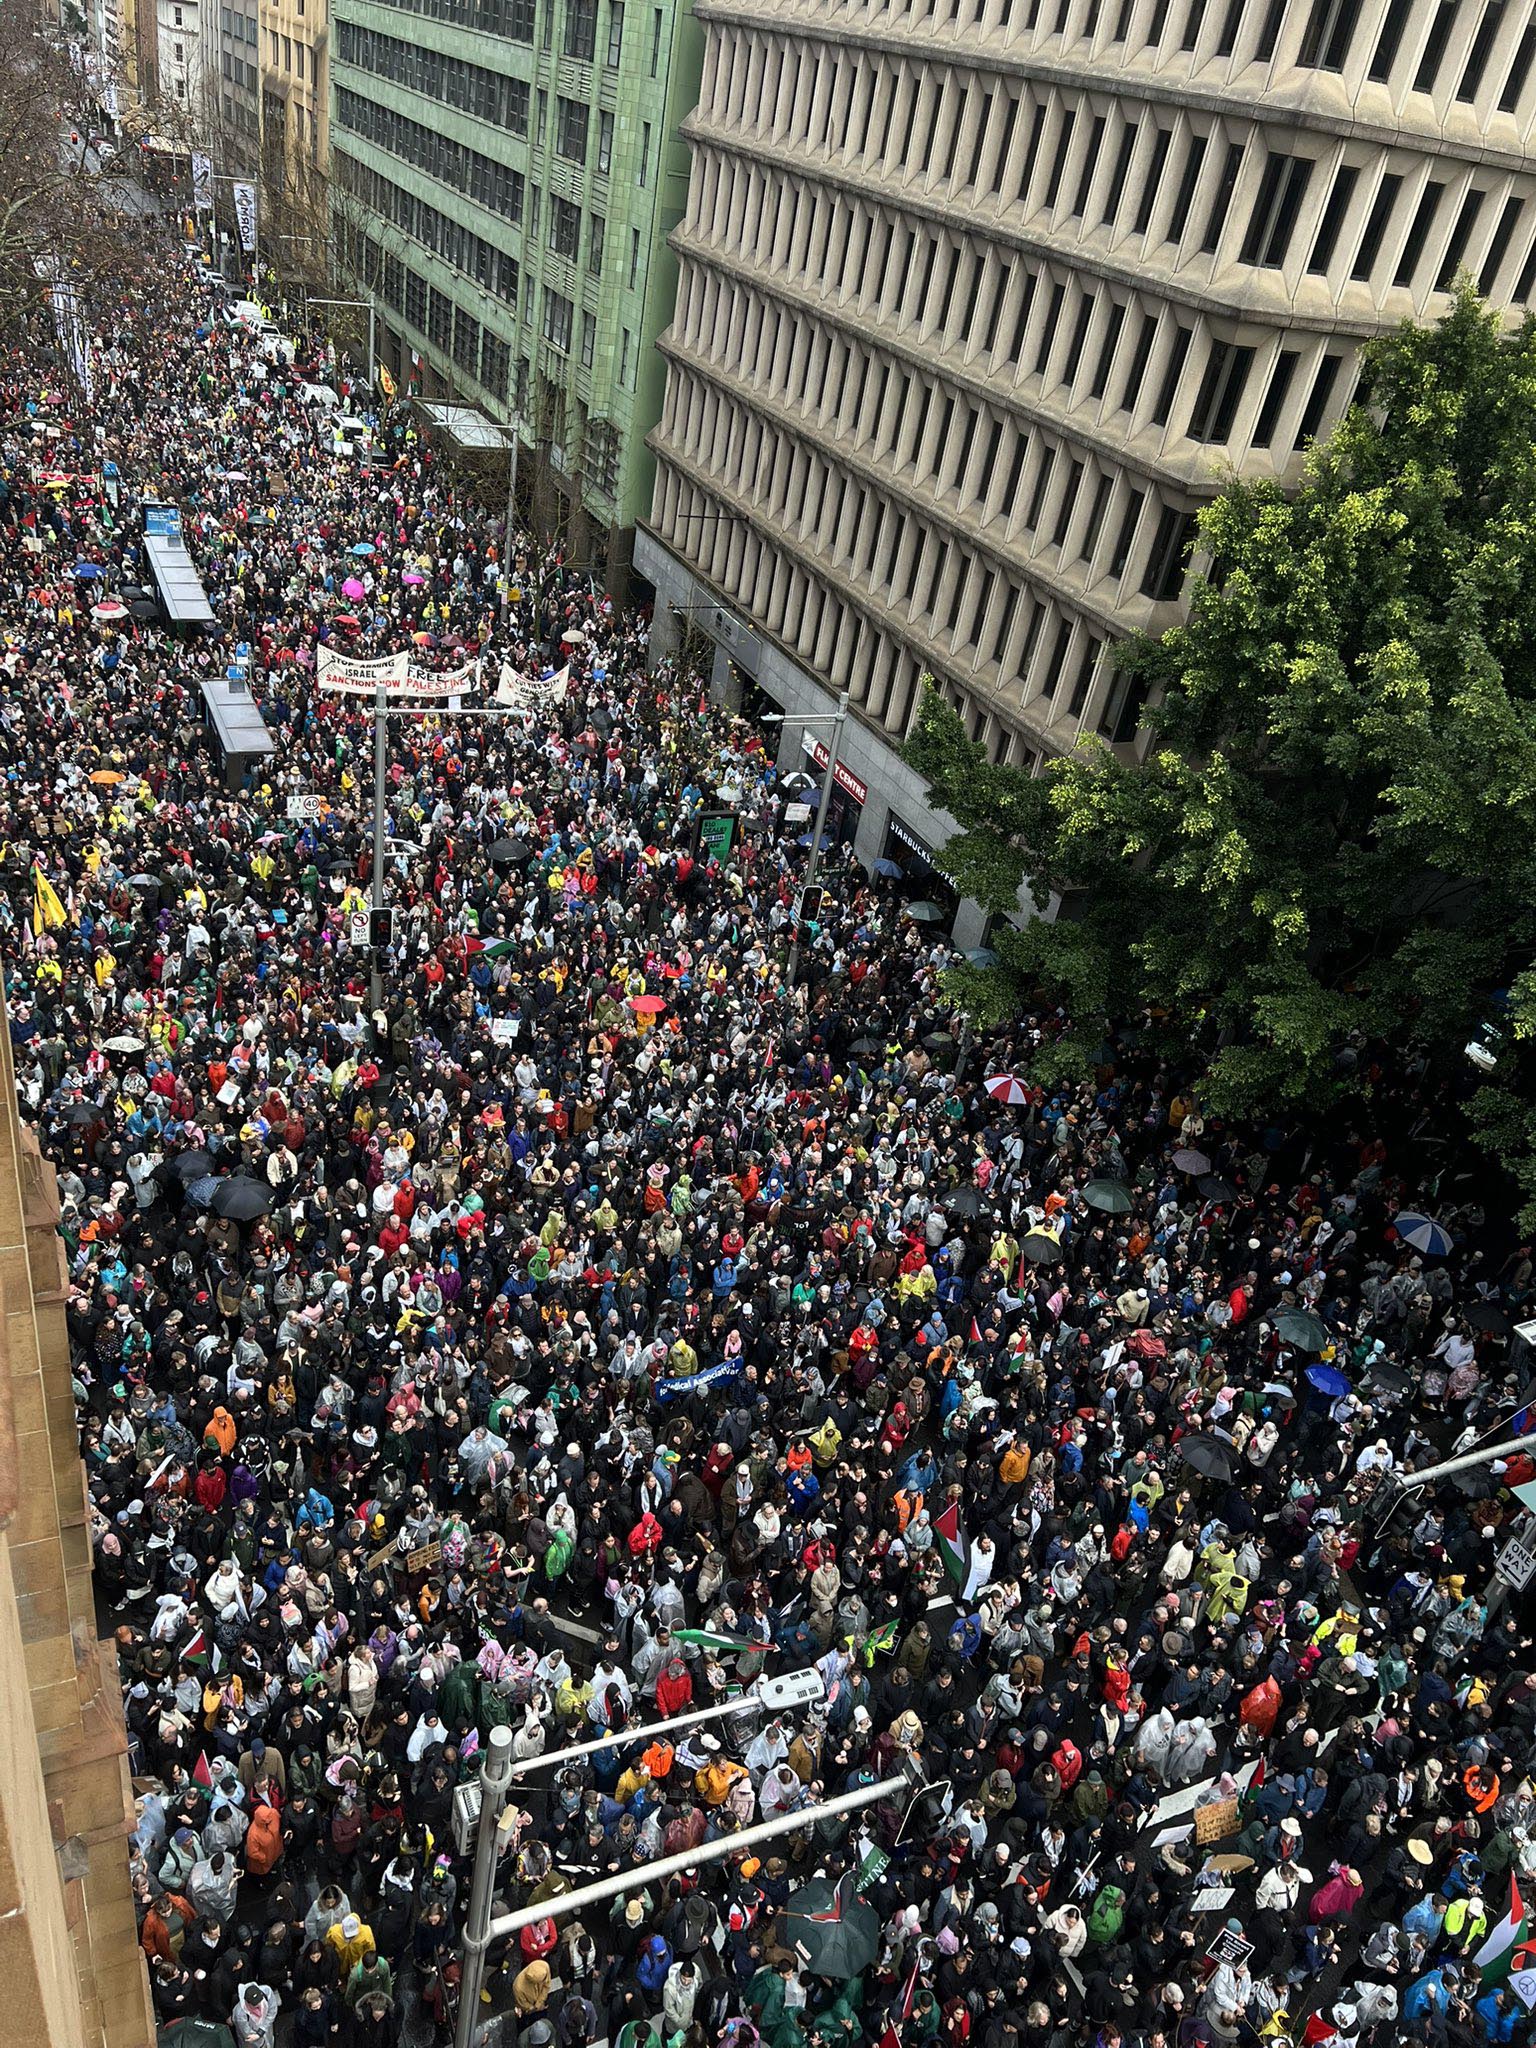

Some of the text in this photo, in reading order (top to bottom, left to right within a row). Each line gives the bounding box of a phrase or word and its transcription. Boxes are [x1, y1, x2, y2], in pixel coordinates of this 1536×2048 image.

[331, 655, 395, 669] STOP ARMING
[236, 667, 243, 675] N
[345, 668, 377, 678] ISRAEL
[326, 673, 377, 687] SANCTIONS
[815, 746, 866, 800] FLIT CENTRE
[305, 800, 318, 808] 40
[890, 821, 931, 864] STARBUCKS
[1511, 1543, 1533, 1568] ONE
[1504, 1550, 1528, 1576] WAY
